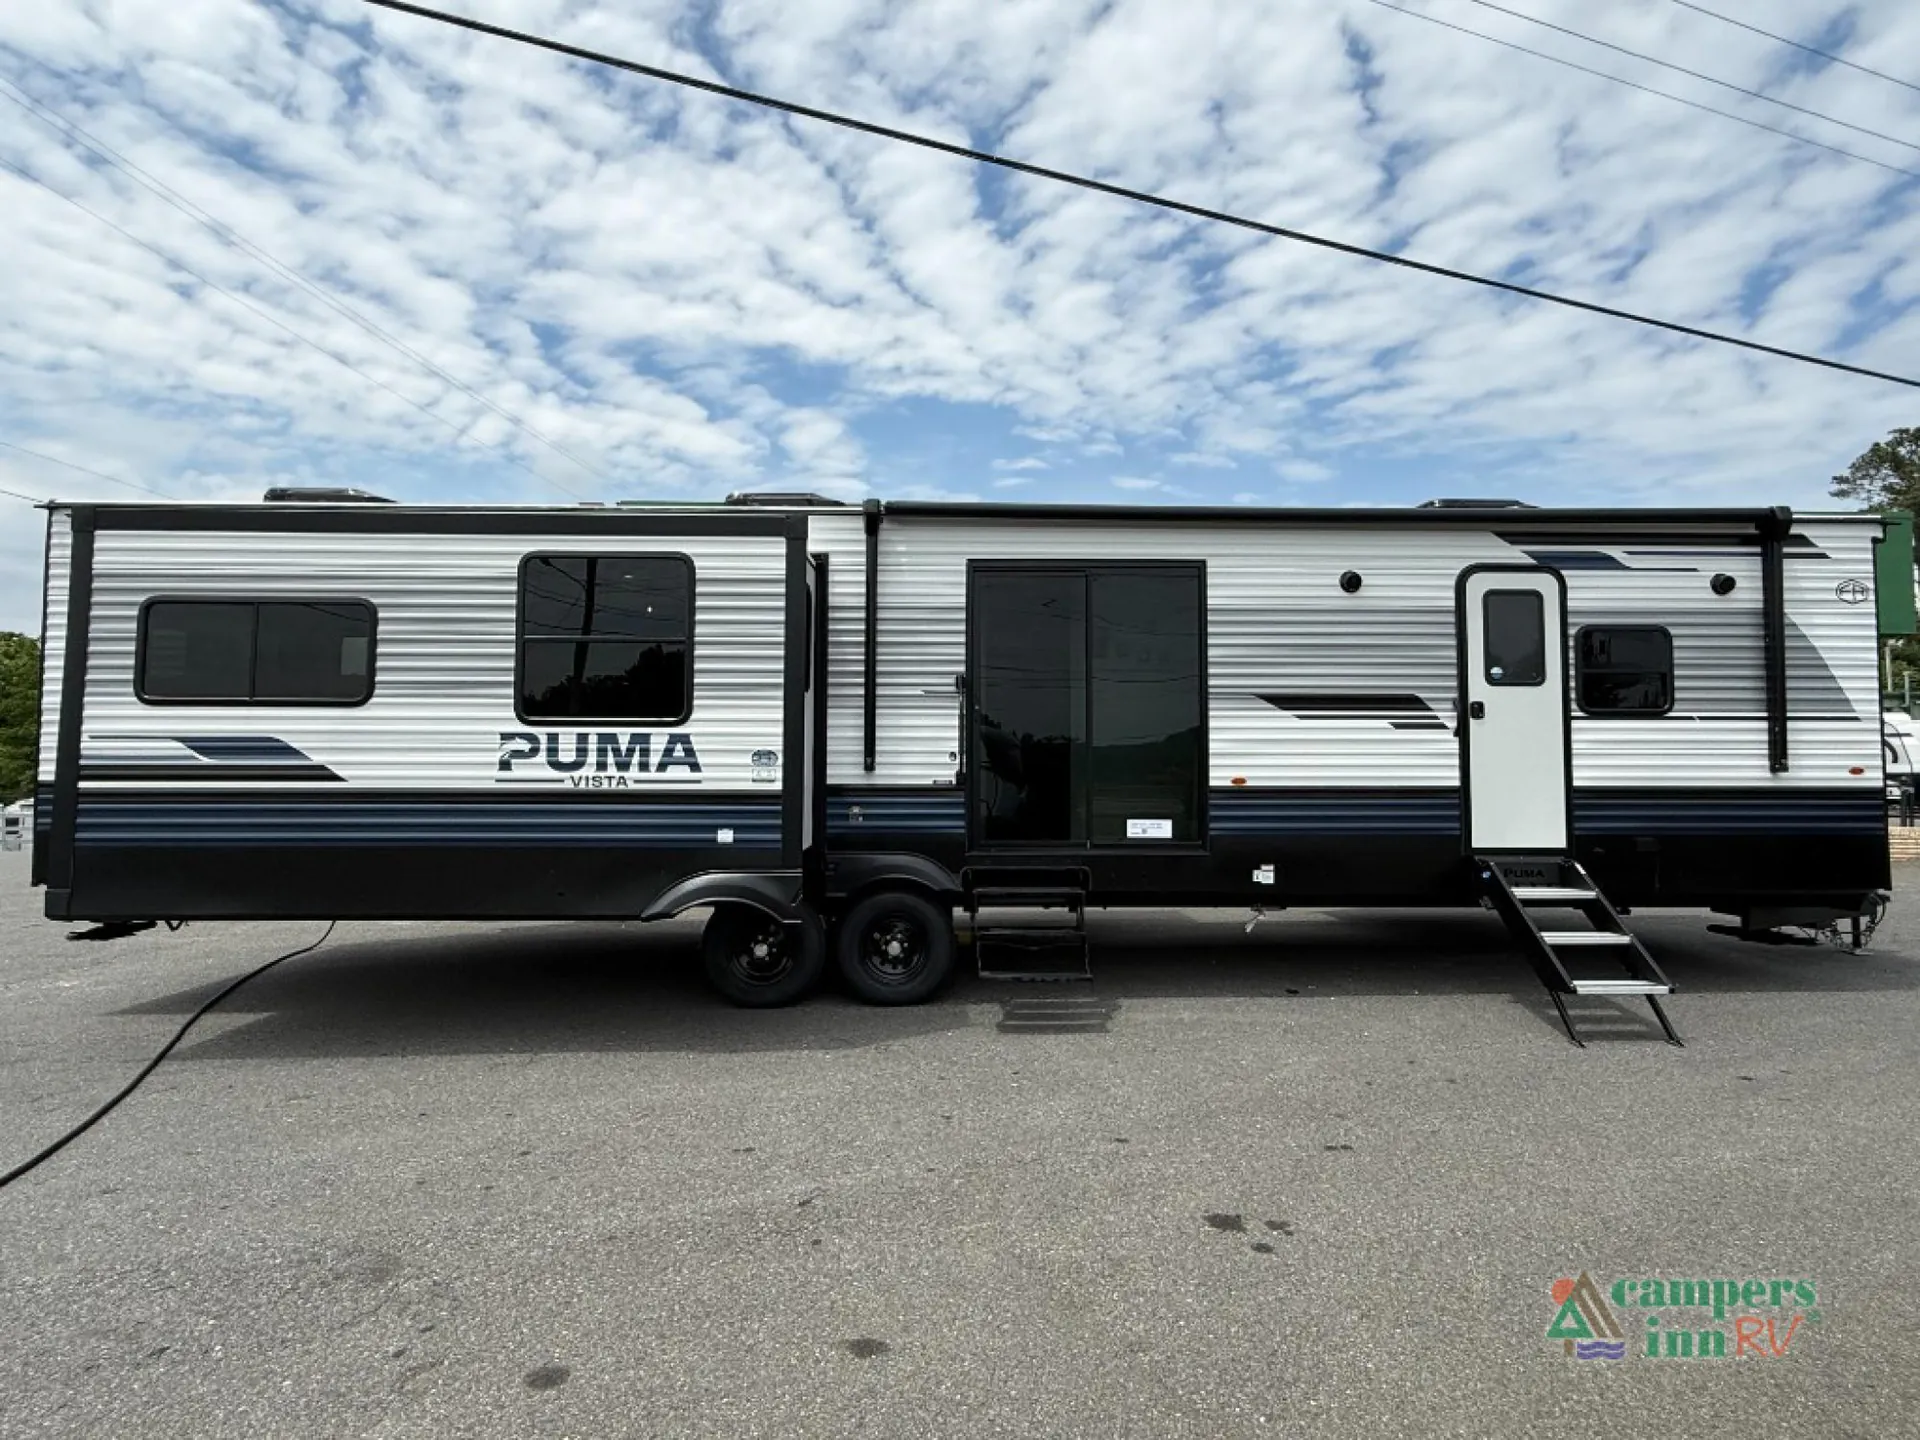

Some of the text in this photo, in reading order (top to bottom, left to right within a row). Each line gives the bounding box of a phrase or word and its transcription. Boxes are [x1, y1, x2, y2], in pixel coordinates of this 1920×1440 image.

[498, 732, 702, 773] PUMA
[569, 775, 629, 788] VISTA
[1503, 868, 1545, 879] PUMA
